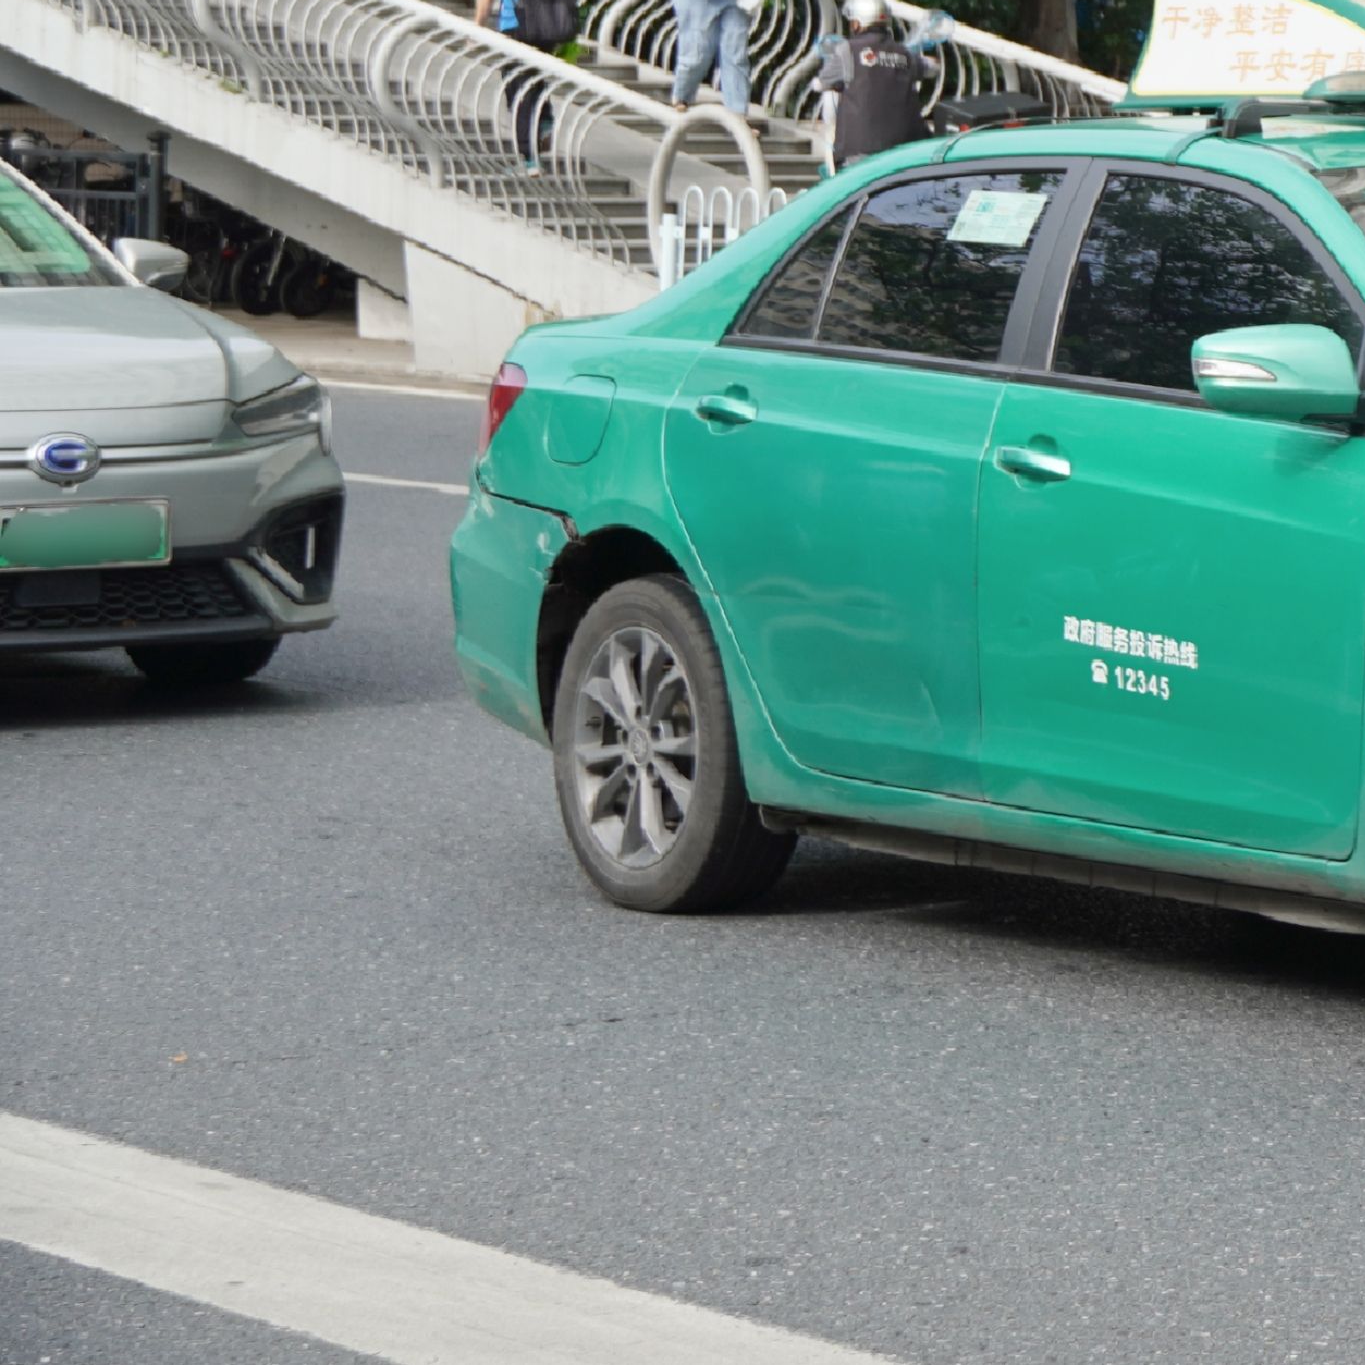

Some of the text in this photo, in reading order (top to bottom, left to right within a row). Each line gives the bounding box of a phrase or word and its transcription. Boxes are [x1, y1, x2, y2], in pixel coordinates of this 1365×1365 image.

[1162, 3, 1293, 39] 干净整洁
[1063, 616, 1198, 669] 政府服务投诉热线
[1115, 666, 1169, 700] 12345
